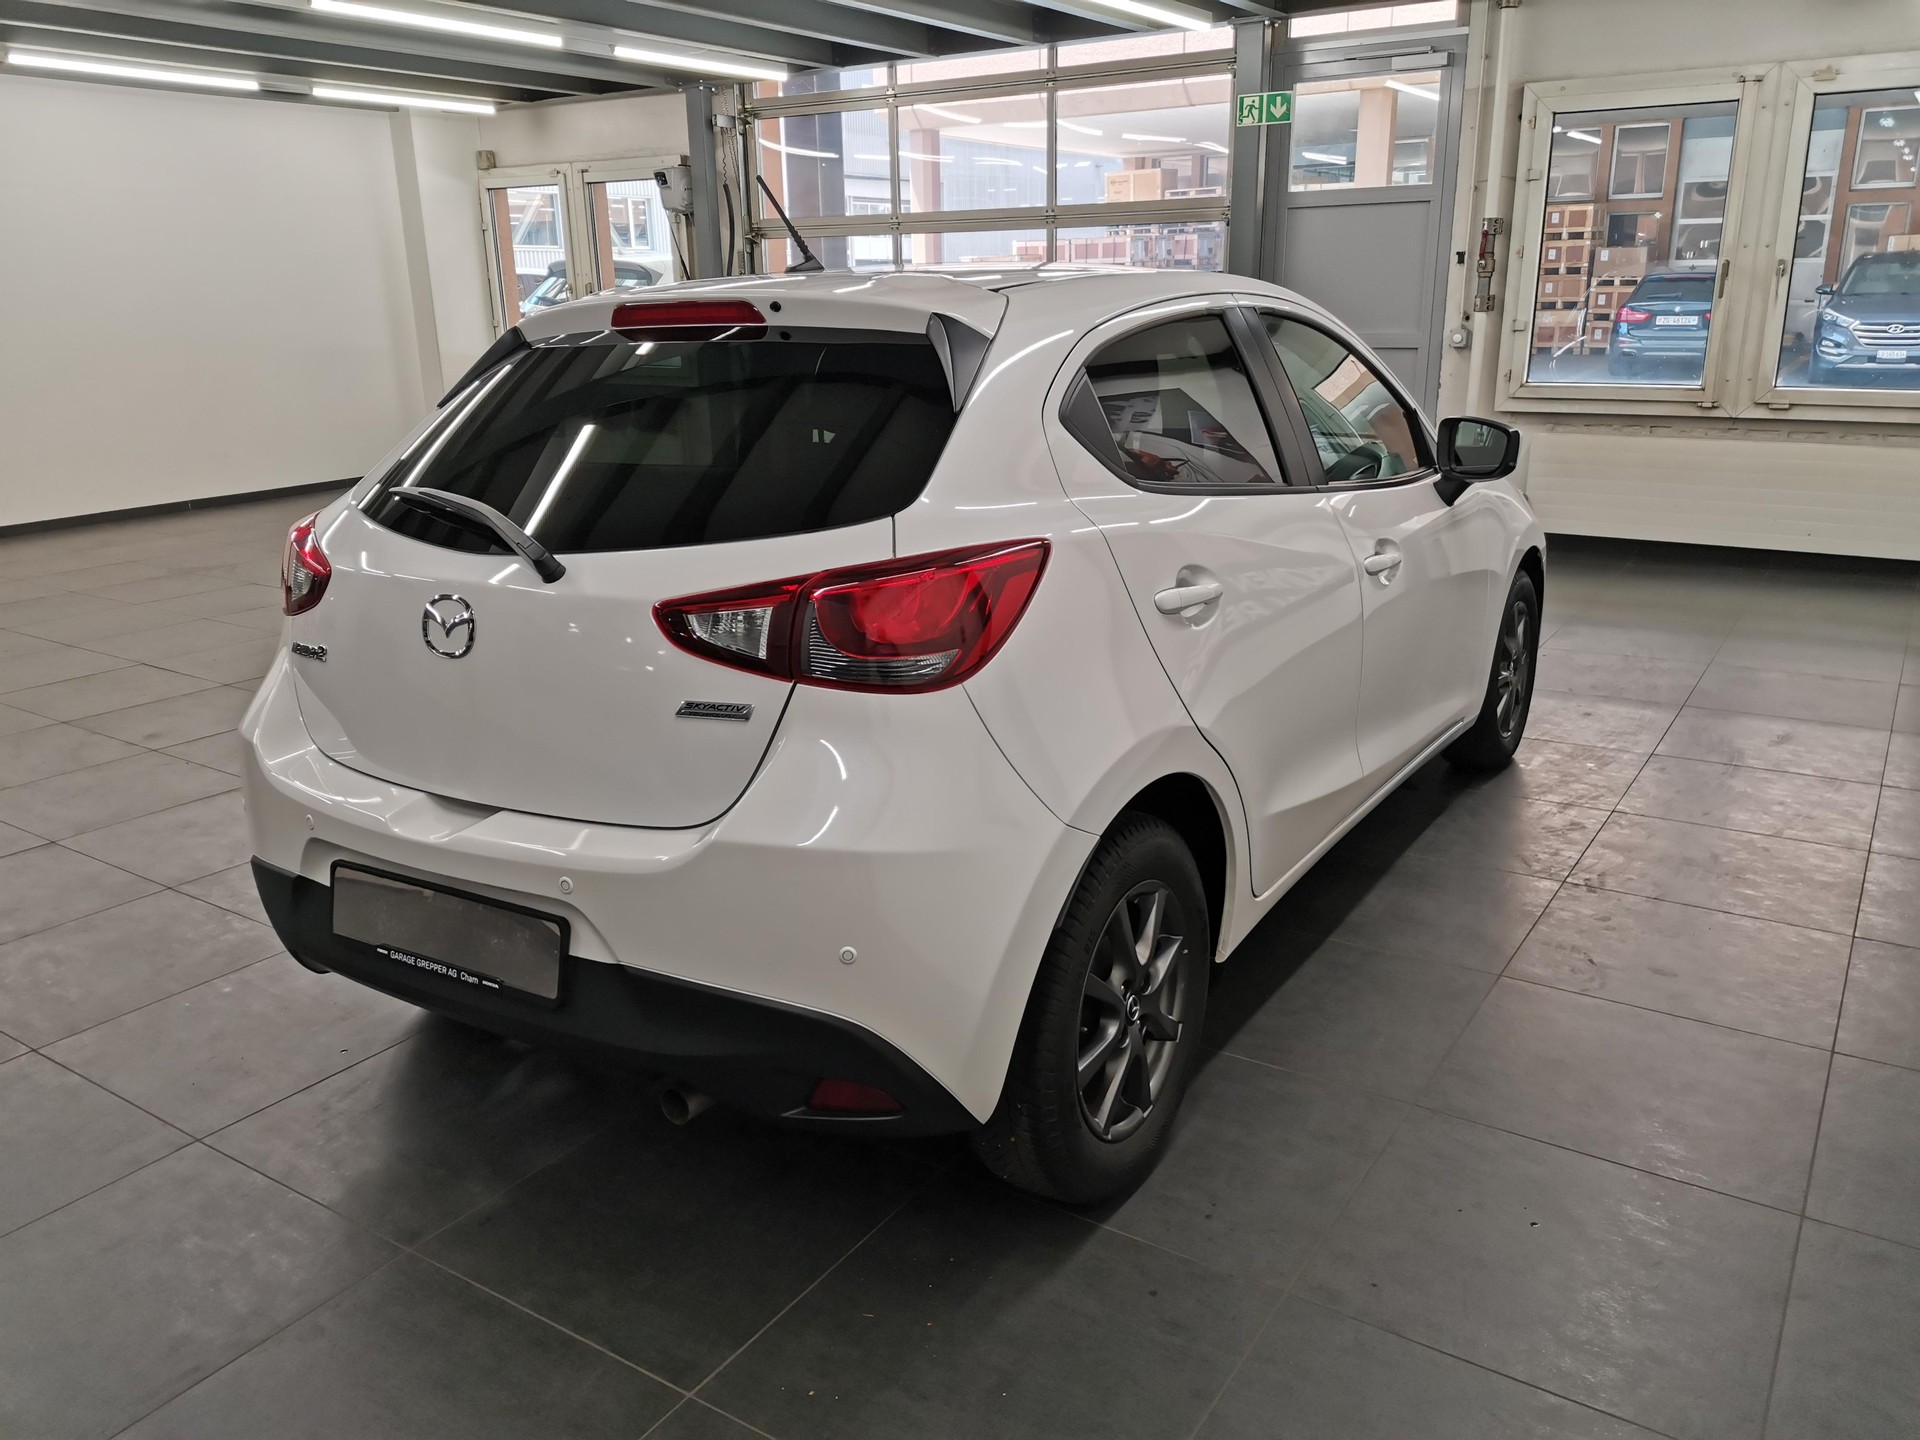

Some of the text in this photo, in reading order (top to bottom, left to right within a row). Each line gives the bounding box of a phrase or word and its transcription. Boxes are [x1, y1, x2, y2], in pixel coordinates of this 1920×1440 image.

[684, 702, 747, 712] SKYACTIV
[390, 950, 416, 966] GARAGE
[416, 958, 447, 975] GREPPER
[447, 968, 458, 978] AG
[460, 971, 479, 985] Cham
